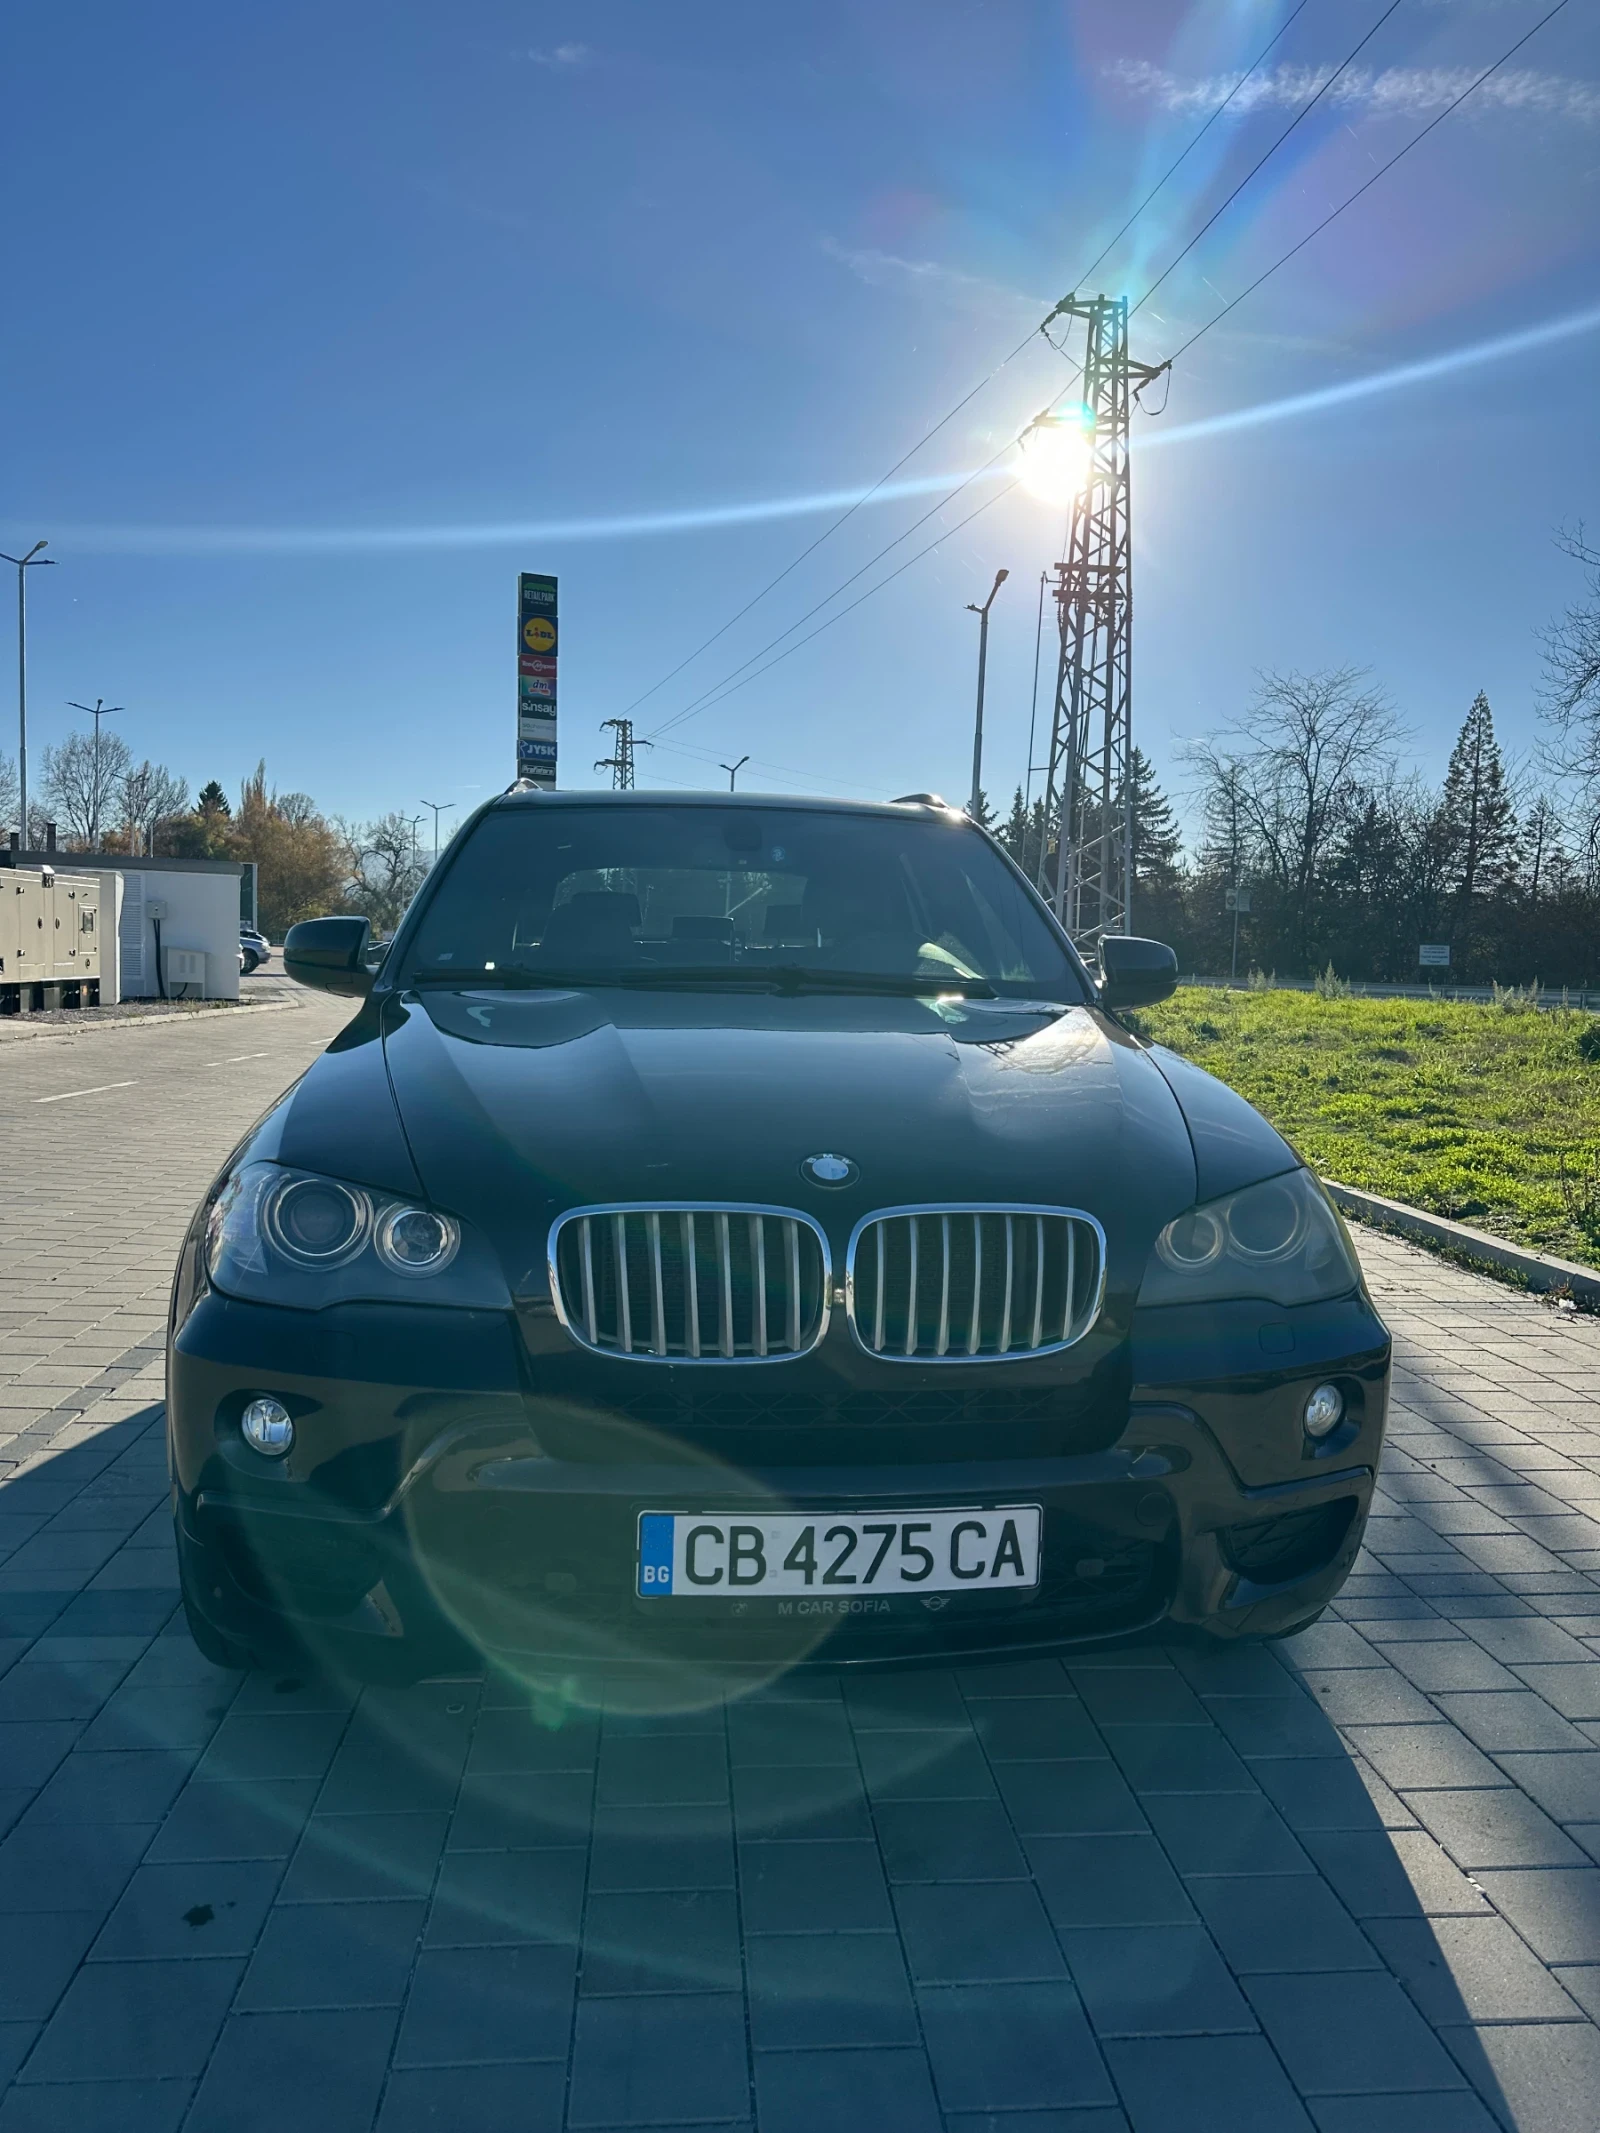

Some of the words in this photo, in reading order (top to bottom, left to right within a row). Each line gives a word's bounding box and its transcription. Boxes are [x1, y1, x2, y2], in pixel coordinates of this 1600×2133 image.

[533, 680, 548, 690] dm
[522, 700, 556, 717] sinsay
[527, 744, 556, 757] JYSK
[806, 1153, 853, 1165] BMW
[685, 1525, 767, 1586] CB
[783, 1522, 934, 1586] 4275
[949, 1519, 1026, 1579] CA
[643, 1565, 670, 1584] BG
[778, 1602, 792, 1615] M
[797, 1601, 834, 1615] CAR
[838, 1600, 891, 1615] SOFIA
